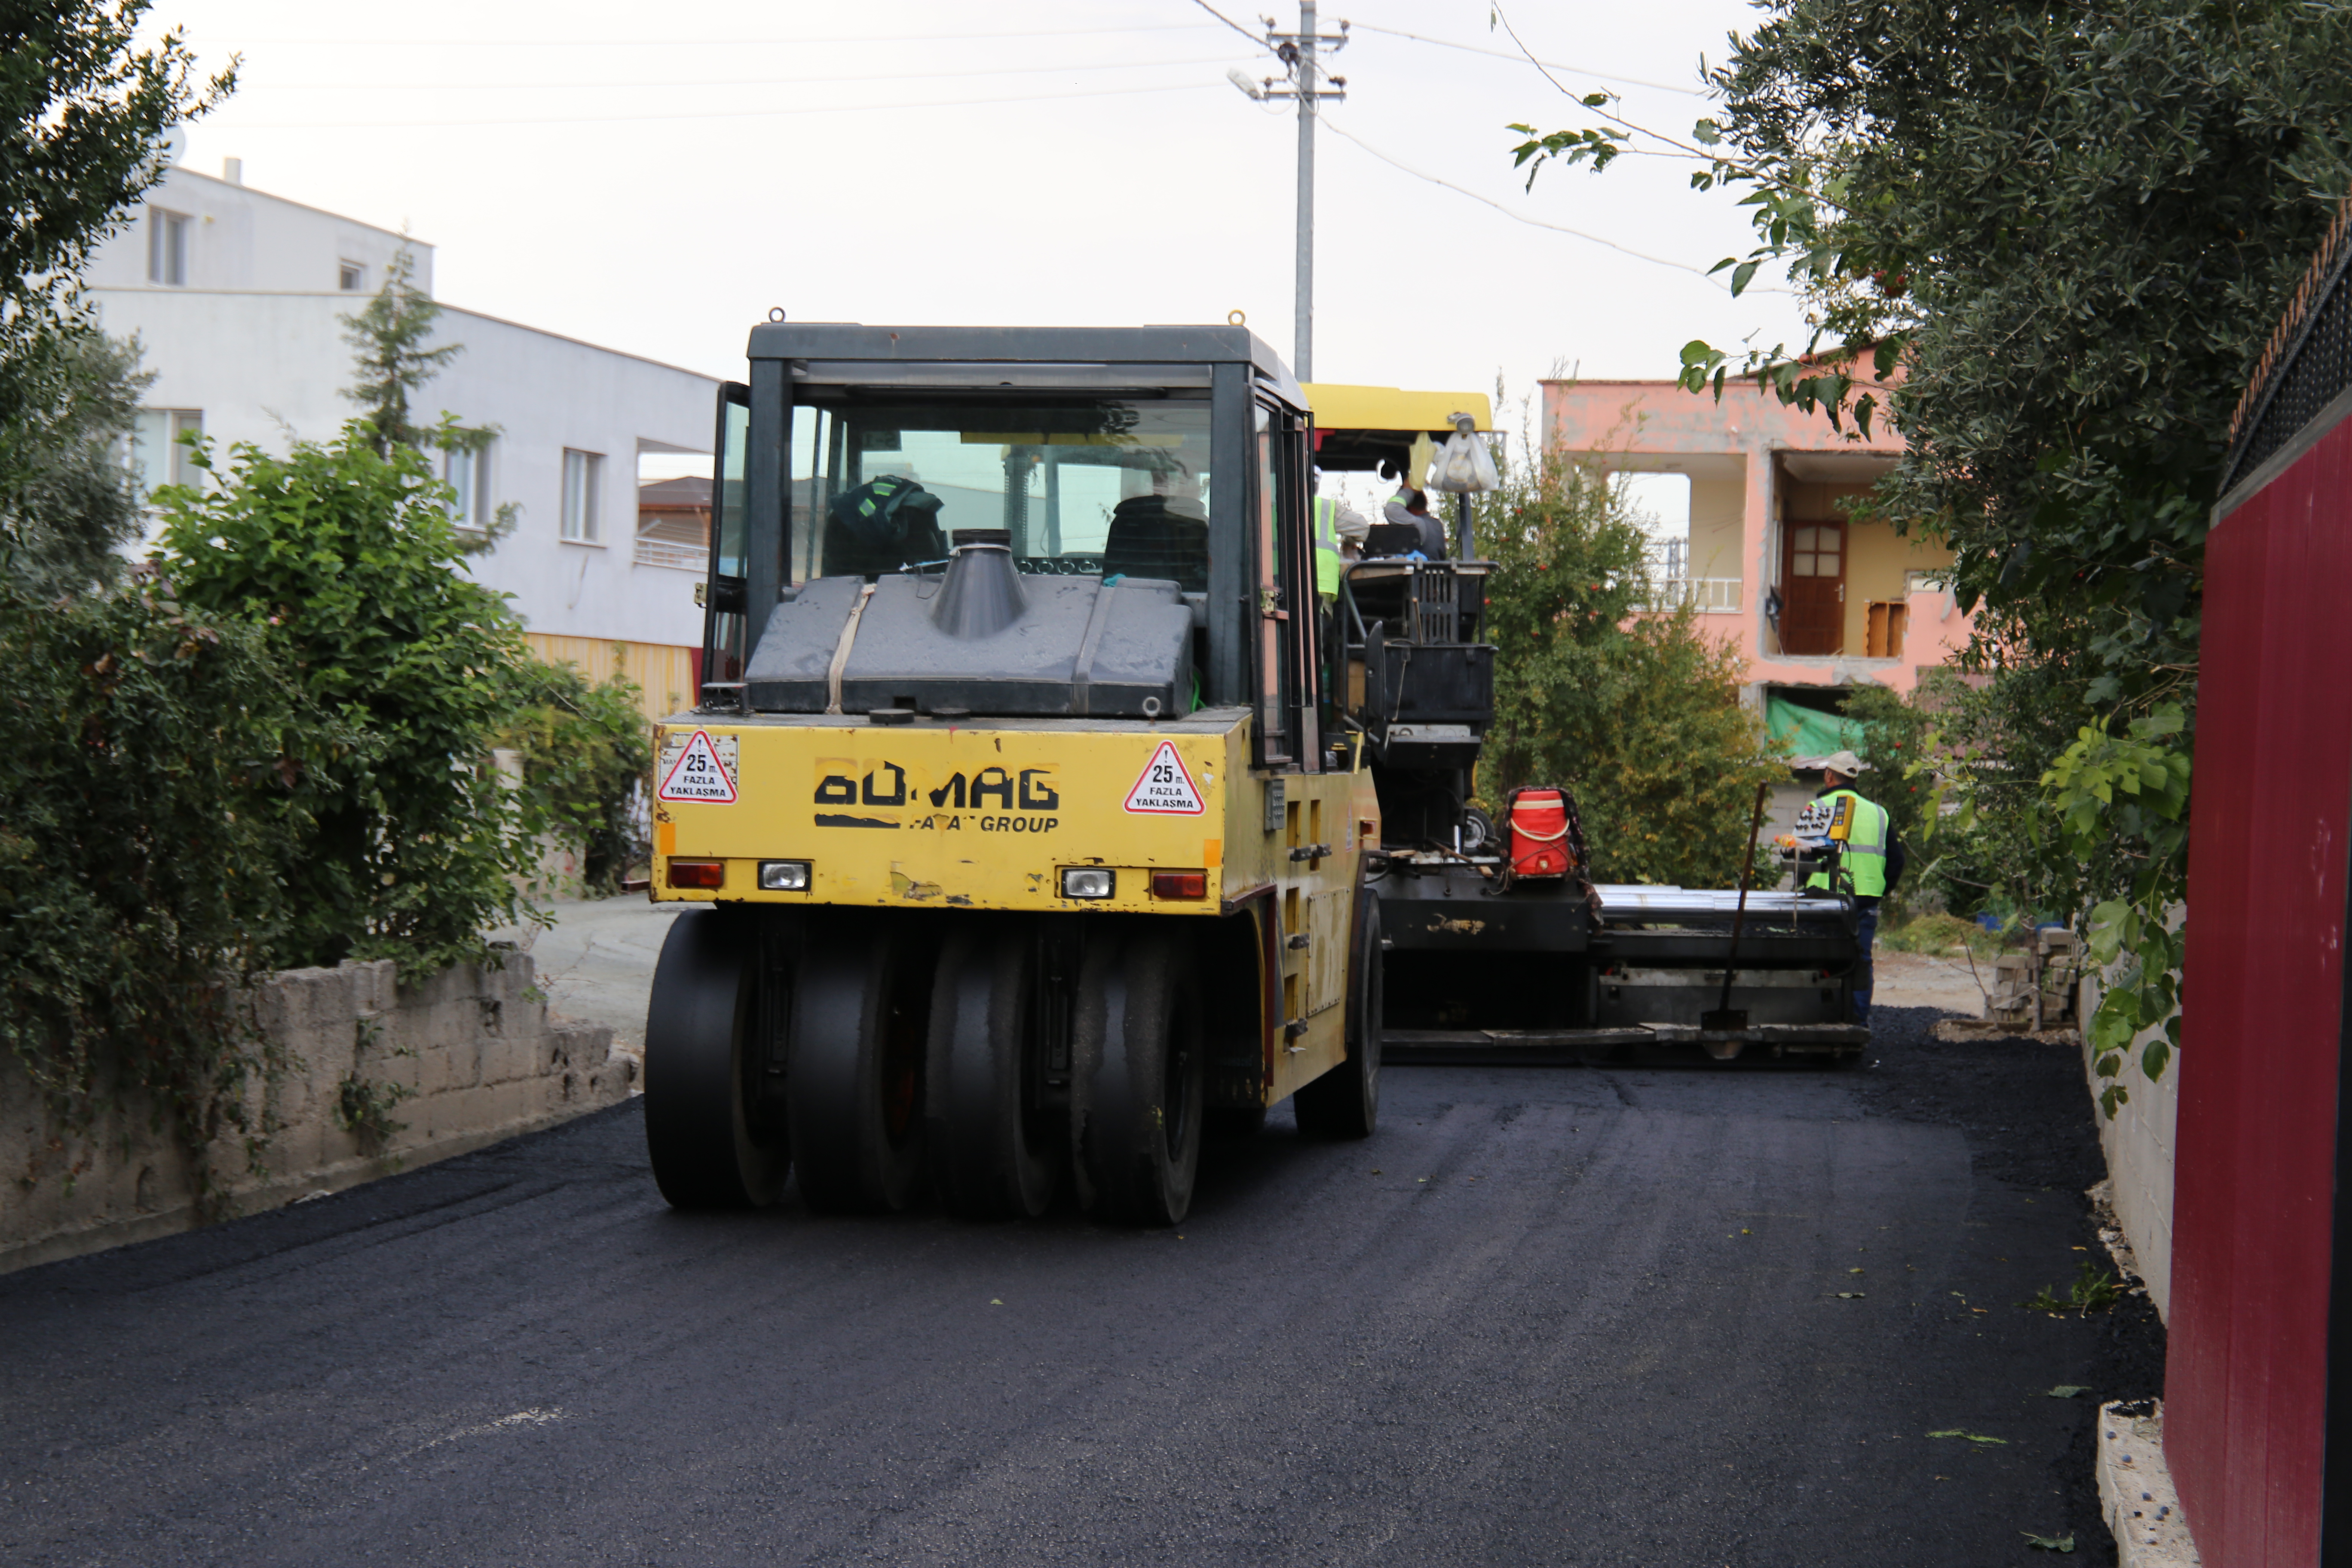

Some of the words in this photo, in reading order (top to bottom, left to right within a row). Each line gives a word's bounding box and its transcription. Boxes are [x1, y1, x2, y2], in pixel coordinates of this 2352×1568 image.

[698, 739, 701, 752] !
[1164, 750, 1168, 763] !
[687, 754, 706, 772] 25
[709, 765, 717, 773] m.
[683, 775, 715, 785] FAZLA
[1153, 765, 1173, 784] 25
[1176, 776, 1185, 784] m.
[671, 787, 726, 797] YAKLAŞMA
[1150, 787, 1182, 796] FAZLA
[1136, 798, 1194, 808] YAKLAŞMA
[980, 816, 1059, 833] GROUP
